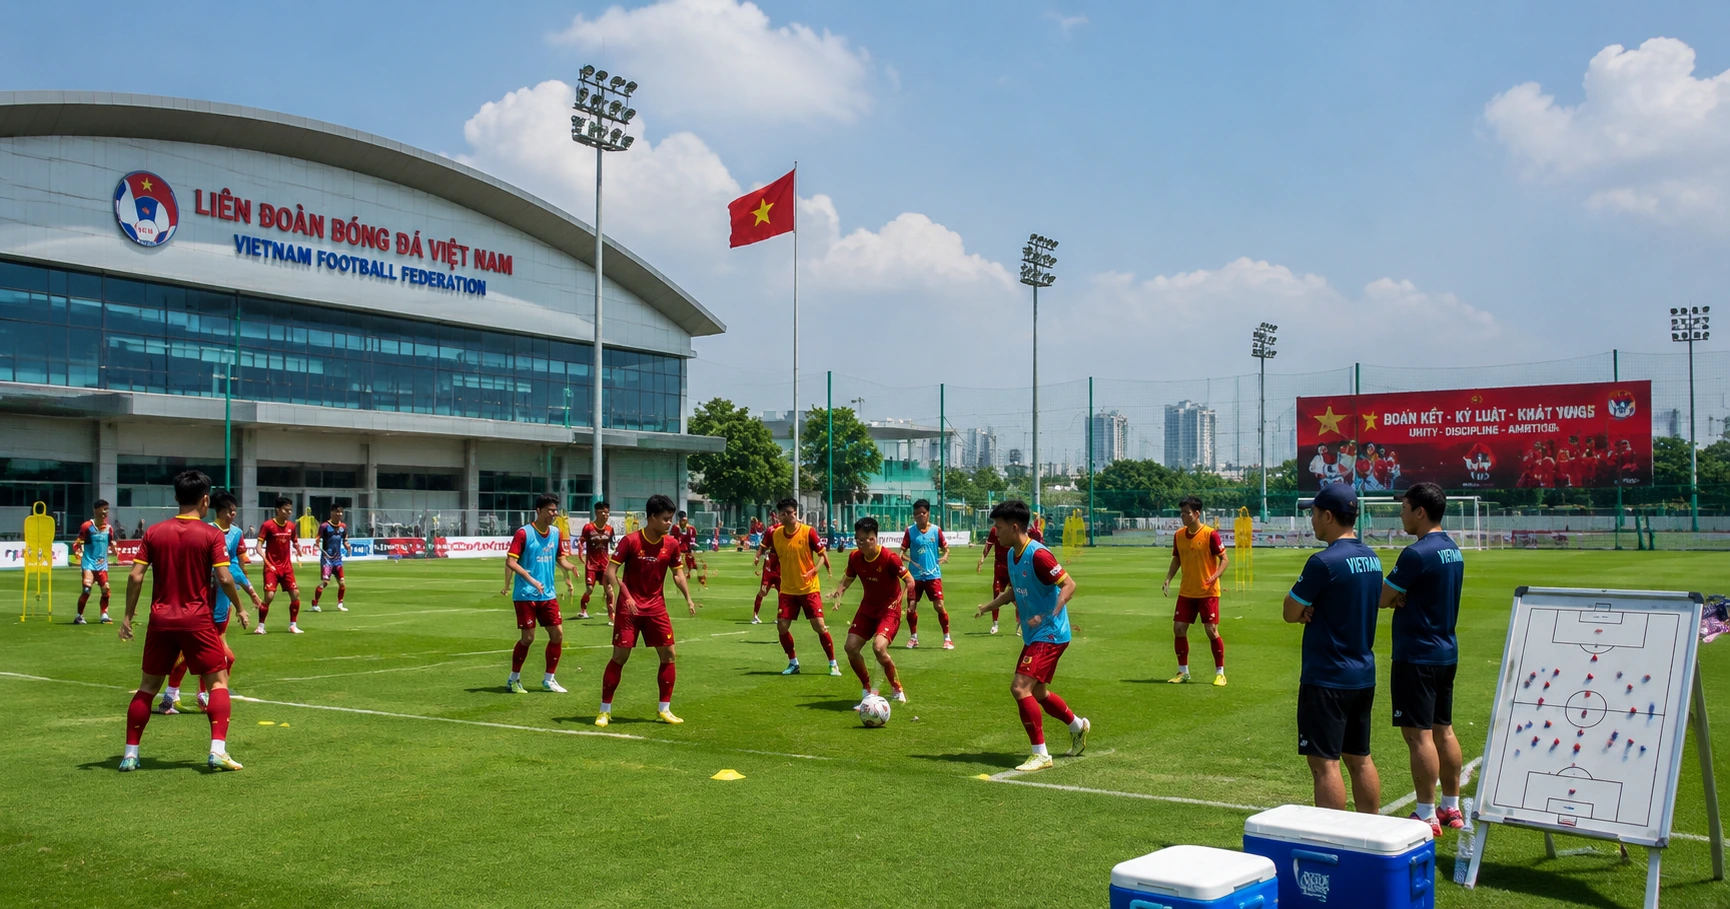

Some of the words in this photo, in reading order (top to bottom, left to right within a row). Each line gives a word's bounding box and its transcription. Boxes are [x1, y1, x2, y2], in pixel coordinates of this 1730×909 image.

[195, 187, 251, 224] LIÊN
[259, 203, 325, 239] ĐOÀN
[331, 216, 390, 251] BÓNG
[396, 230, 424, 258] ĐÁ
[428, 237, 469, 271] VIỆT
[474, 248, 513, 275] NAM
[233, 233, 312, 266] VIETNAM
[316, 249, 398, 281] FOOTBALL
[401, 265, 487, 296] FEDERATION
[1445, 425, 1499, 437] DISCIPLINE
